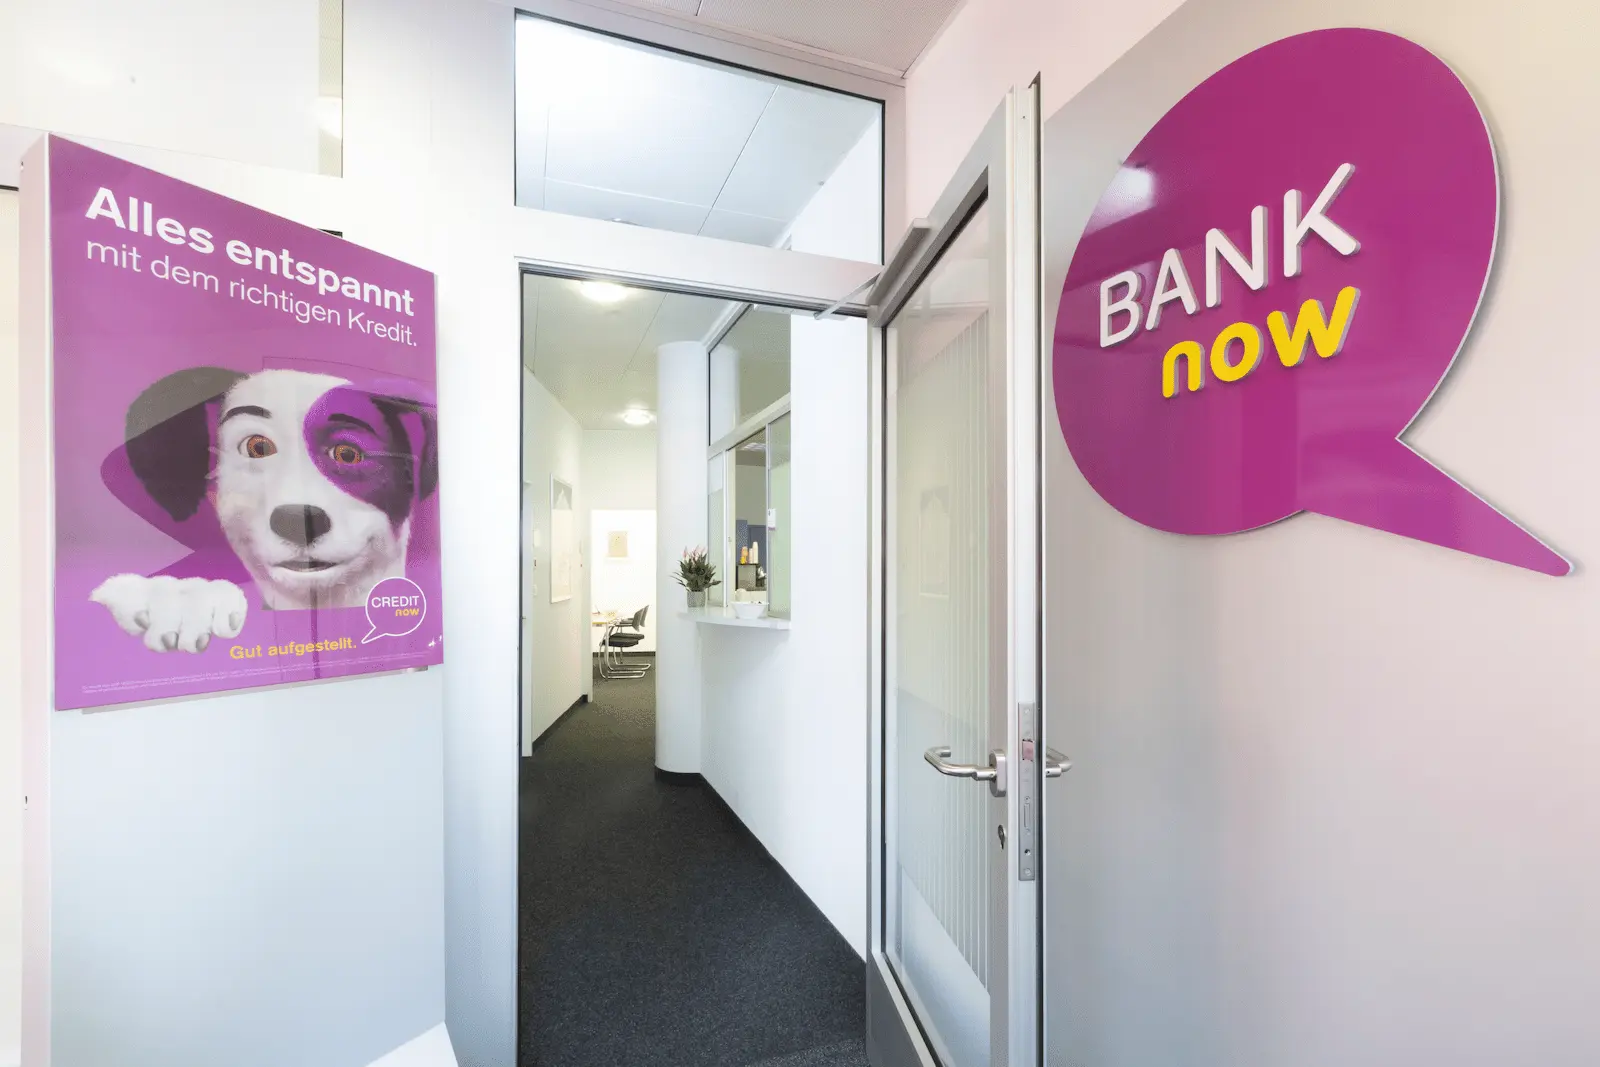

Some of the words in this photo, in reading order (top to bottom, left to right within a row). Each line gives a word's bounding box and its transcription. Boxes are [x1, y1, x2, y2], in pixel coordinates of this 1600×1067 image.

[85, 187, 214, 254] Alles
[226, 239, 414, 316] entspannt
[86, 240, 142, 273] mit
[150, 255, 219, 293] dem
[229, 278, 341, 326] richtigen
[348, 309, 417, 347] Kredit.
[1100, 163, 1360, 347] BANK
[1162, 286, 1360, 398] now
[229, 644, 263, 660] Gut
[268, 637, 357, 657] aufgestellt.
[371, 595, 420, 608] CREDIT
[395, 608, 420, 617] now
